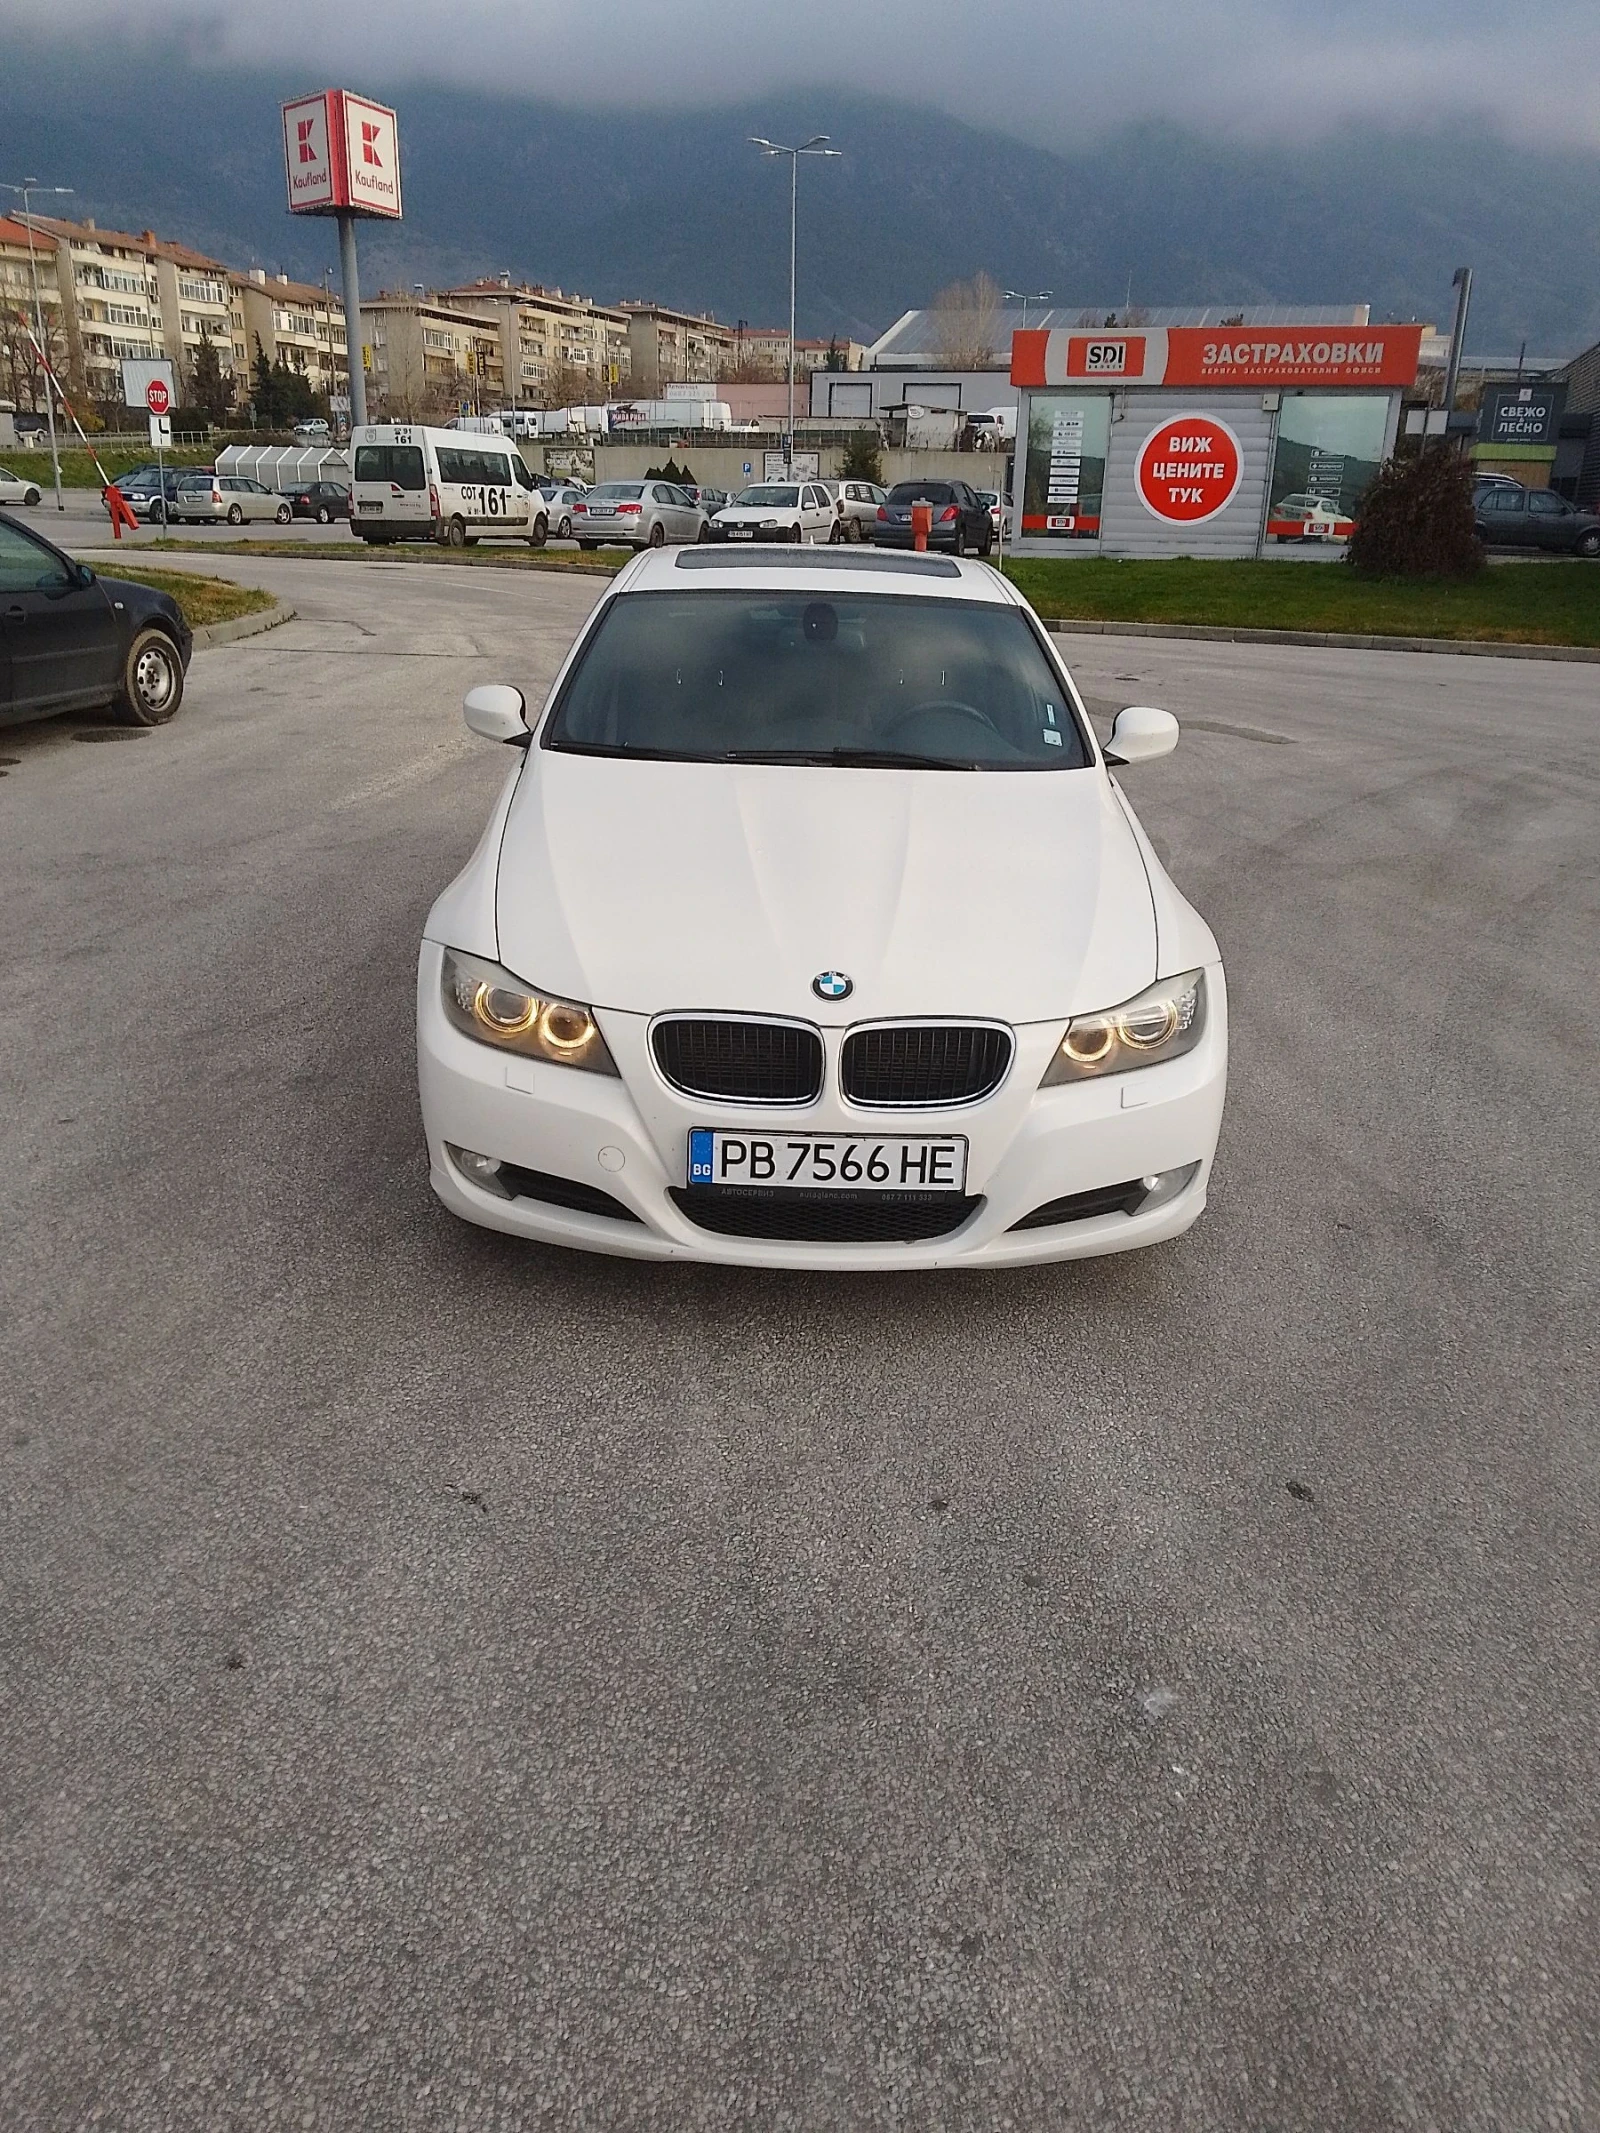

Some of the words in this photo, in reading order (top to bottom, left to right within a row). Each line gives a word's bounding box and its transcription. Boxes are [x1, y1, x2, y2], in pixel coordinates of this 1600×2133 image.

[293, 168, 327, 189] Kaufland
[355, 169, 394, 194] Kaufland
[1089, 346, 1124, 364] SDI
[1203, 343, 1384, 365] ЗАСТРАХОВКИ
[1244, 367, 1339, 375] ЗАСТРАХОВАТЕЛНИ
[149, 390, 167, 403] STOP
[1500, 406, 1546, 417] СВЕЖО
[1498, 422, 1543, 433] ЛЕСНО
[394, 436, 412, 444] 161
[1169, 436, 1213, 453] ВИЖ
[1153, 462, 1225, 480] ЦЕНИТЕ
[479, 487, 507, 515] 161
[1168, 487, 1204, 503] ТУК
[693, 1164, 711, 1176] BG
[721, 1140, 776, 1179] PB
[786, 1142, 890, 1183] 7566
[900, 1145, 955, 1184] HE
[721, 1188, 774, 1197] АВТОСЕРВИЗ
